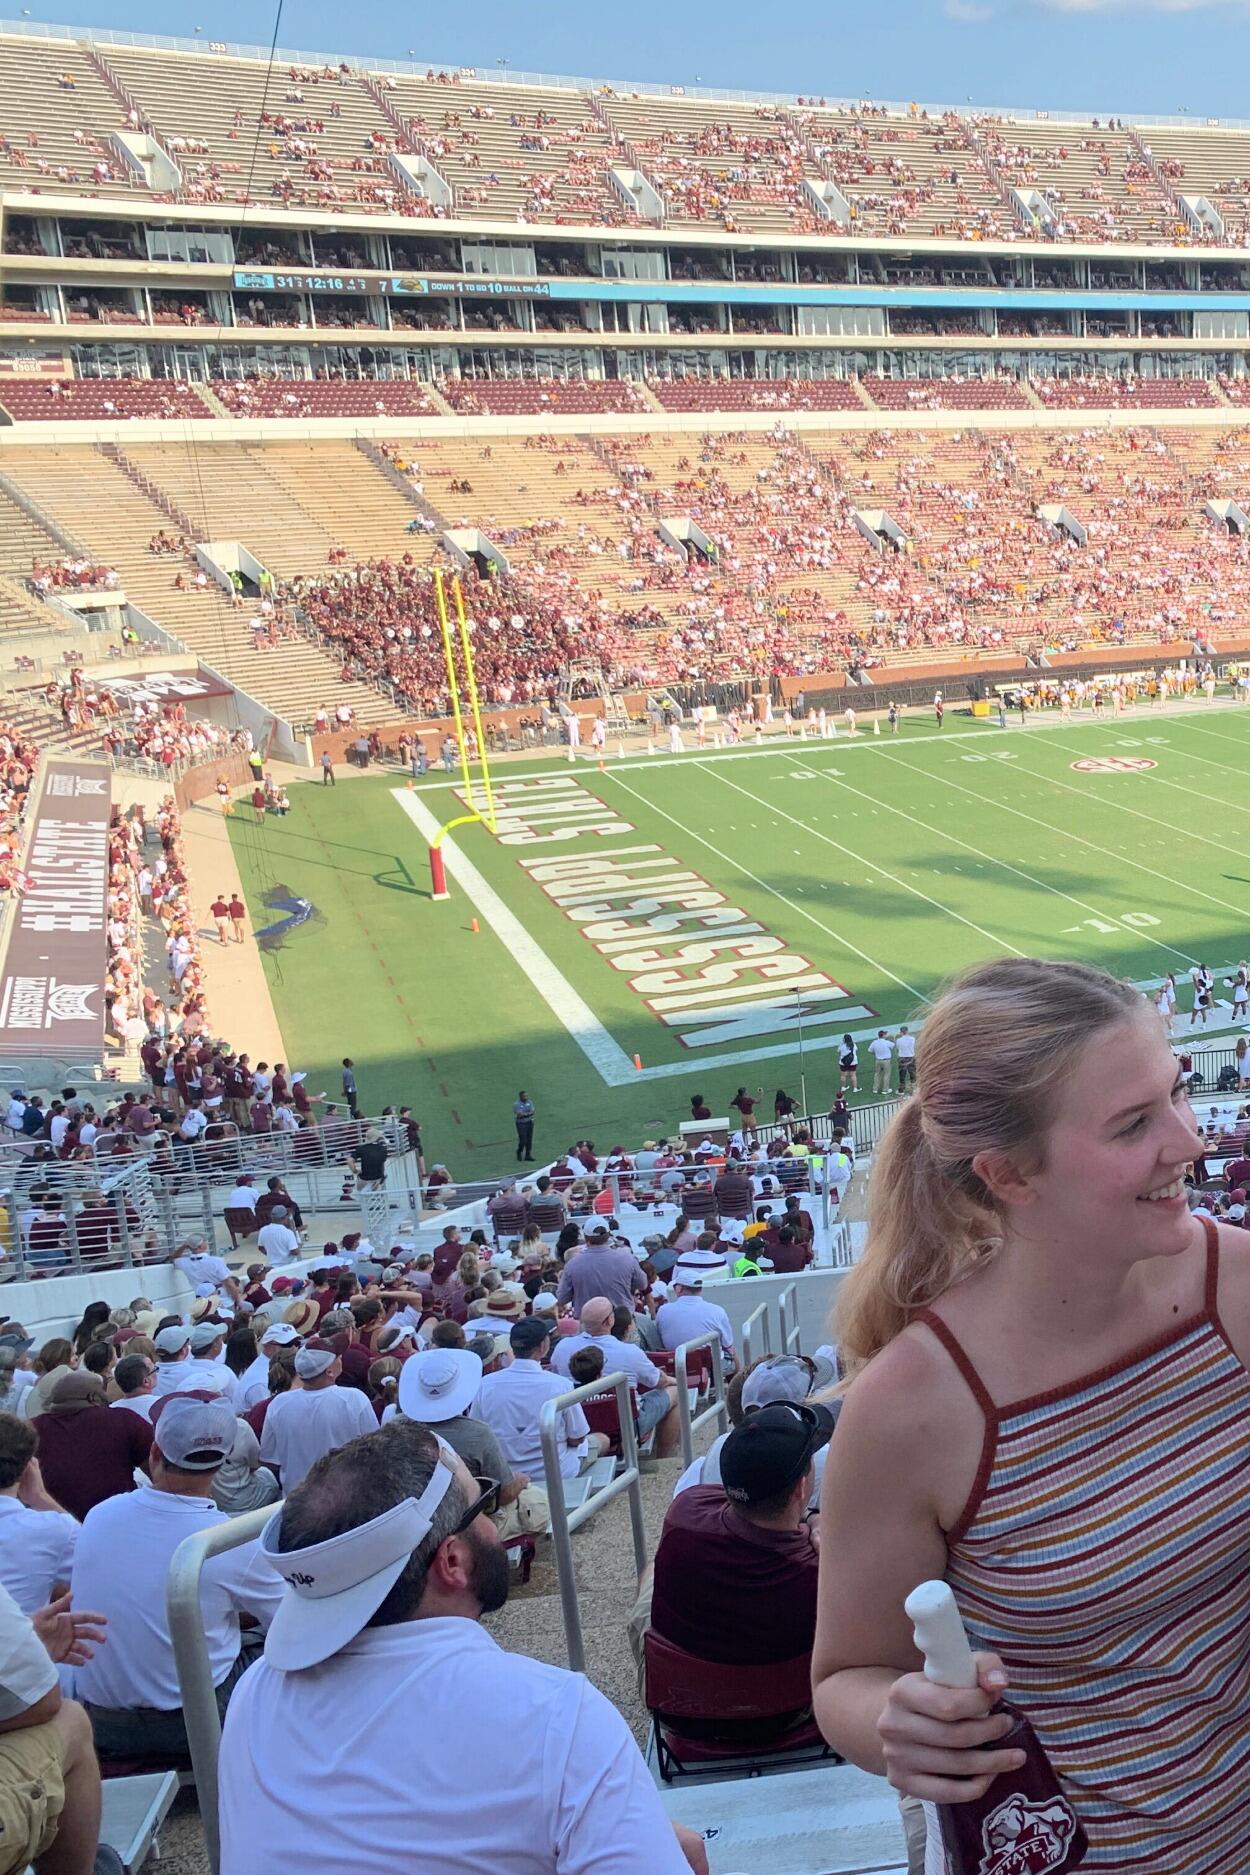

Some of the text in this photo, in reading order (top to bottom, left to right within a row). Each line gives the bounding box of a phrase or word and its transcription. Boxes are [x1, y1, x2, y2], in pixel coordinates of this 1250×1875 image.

[277, 276, 293, 288] 31
[306, 277, 343, 289] 12:16
[378, 281, 387, 292] 7
[431, 282, 455, 290] DOWN
[456, 281, 463, 292] 1
[465, 283, 475, 291] TO
[488, 282, 501, 293] 10
[503, 284, 522, 293] BALL
[534, 284, 549, 295] 44
[451, 777, 637, 845] STATE
[20, 818, 108, 932] #HAILSTATE
[1083, 911, 1162, 934] 10
[515, 843, 881, 1049] MISSISSIPPI
[7, 976, 47, 1029] MISSISSIPPI
[994, 1841, 1043, 1875] STATE
